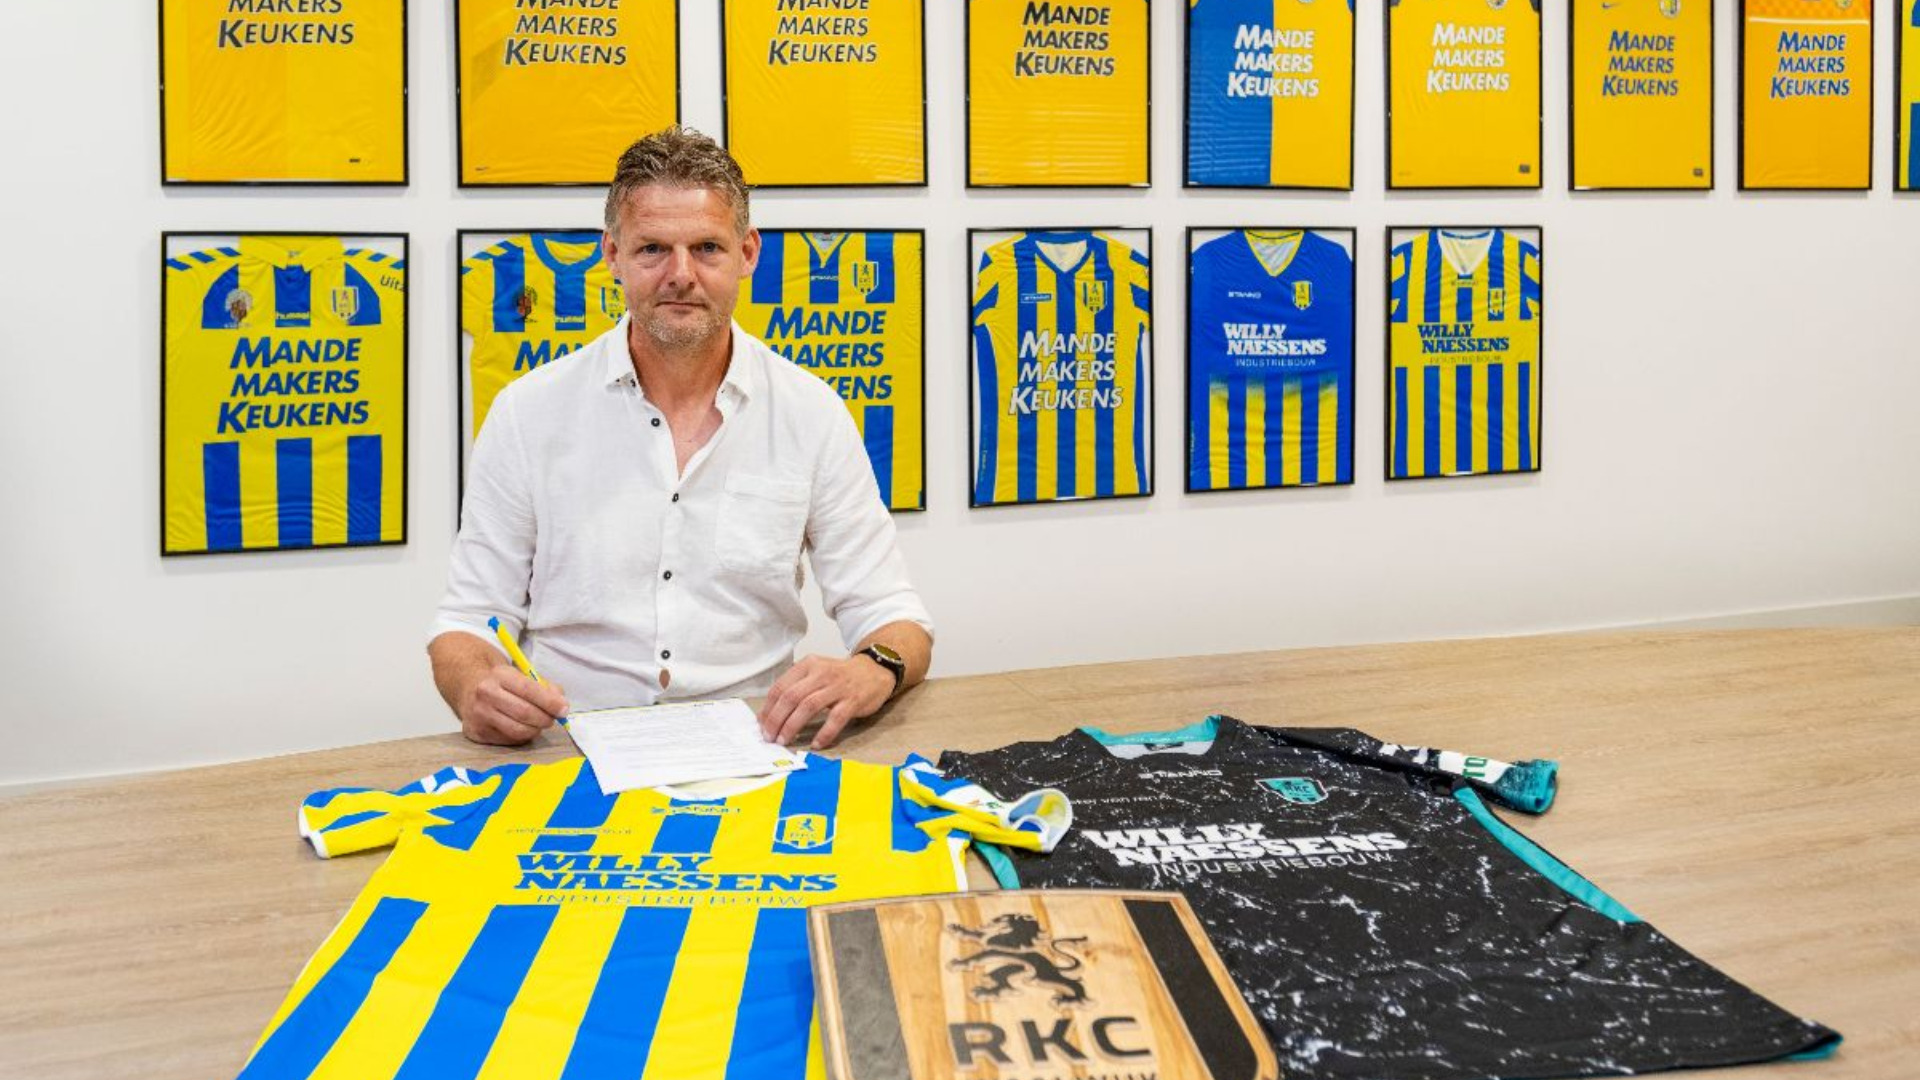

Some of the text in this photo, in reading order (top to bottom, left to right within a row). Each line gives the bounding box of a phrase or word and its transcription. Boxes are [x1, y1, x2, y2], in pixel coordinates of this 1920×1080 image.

[515, 14, 618, 37] MAKERS
[1022, 1, 1111, 26] MANDE
[218, 19, 355, 48] KEUKENS
[776, 16, 869, 37] MAKERS
[1233, 23, 1316, 50] MANDE
[1431, 22, 1507, 47] MANDE
[504, 38, 628, 66] KEUKENS
[767, 39, 878, 65] KEUKENS
[1023, 29, 1110, 50] MAKERS
[1608, 29, 1676, 52] MANDE
[1776, 31, 1847, 53] MANDE
[1014, 51, 1115, 77] KEUKENS
[1234, 51, 1314, 73] MAKERS
[1432, 48, 1506, 68] MAKERS
[1609, 56, 1675, 74] MAKERS
[1777, 56, 1846, 74] MAKERS
[1226, 71, 1320, 98] KEUKENS
[1426, 68, 1511, 94] KEUKENS
[1601, 74, 1679, 97] KEUKENS
[1769, 76, 1851, 99] KEUKENS
[764, 306, 887, 340] MANDE
[1222, 321, 1287, 340] WILLY
[1417, 323, 1475, 338] WILLY
[229, 336, 363, 370] MANDE
[1018, 329, 1119, 358] MANDE
[1226, 338, 1328, 356] NAESSENS
[1421, 336, 1510, 353] NAESSENS
[229, 369, 361, 398] MAKERS
[1018, 360, 1117, 383] MAKERS
[1008, 386, 1124, 416] KEUKENS
[216, 400, 370, 435] KEUKENS
[1080, 822, 1267, 850] WILLY
[1108, 831, 1409, 868] NAESSENS
[516, 853, 714, 872] WILLY
[1152, 851, 1398, 876] INDUSTRIEBOUW
[513, 872, 838, 891] NAESSENS
[948, 1016, 1153, 1067] RKC
